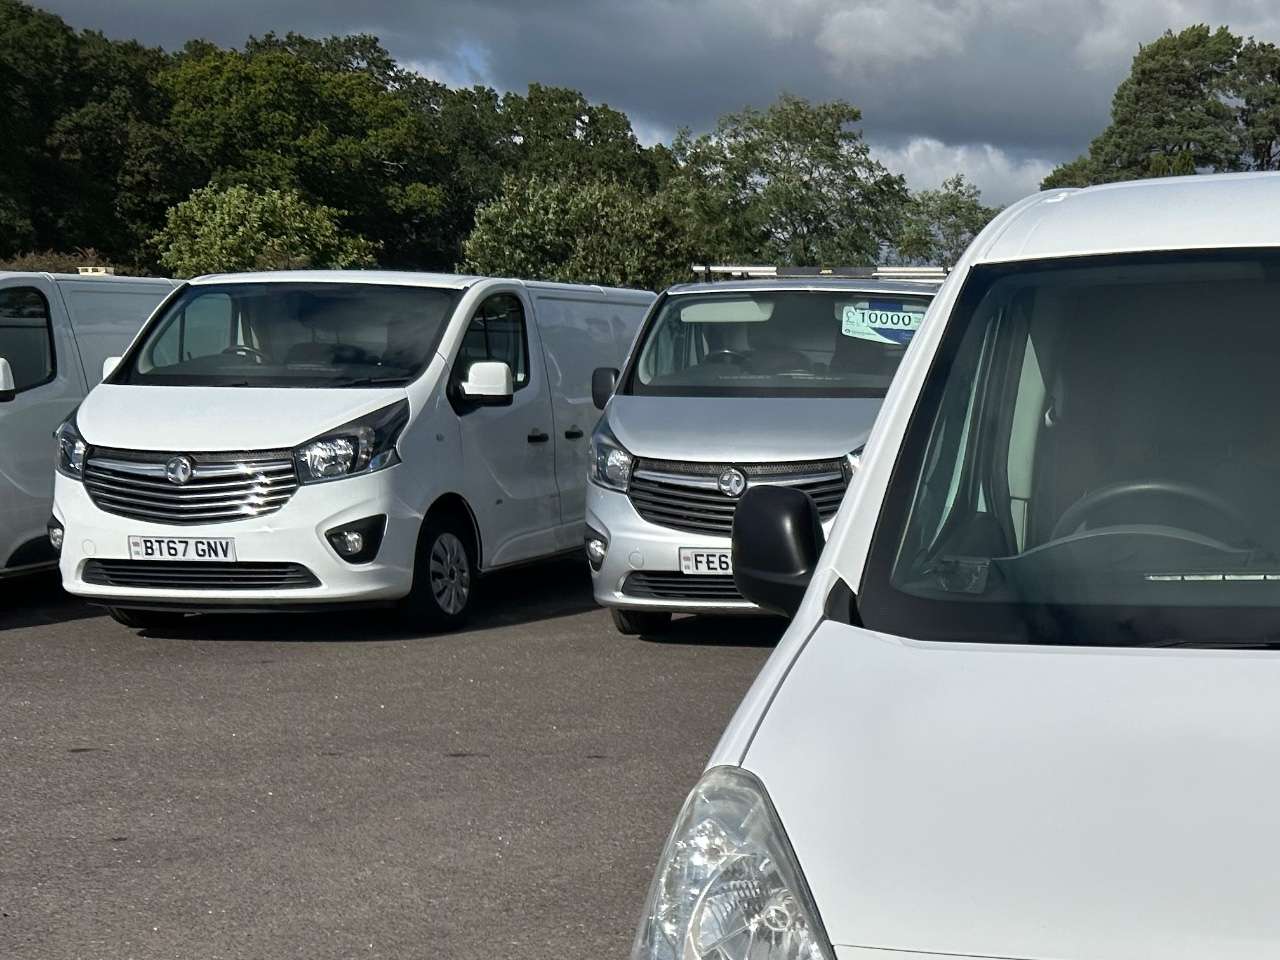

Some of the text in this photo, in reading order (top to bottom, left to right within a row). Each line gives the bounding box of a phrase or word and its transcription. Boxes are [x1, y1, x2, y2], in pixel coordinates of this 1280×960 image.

[143, 540, 230, 558] BT67 GNV
[694, 553, 730, 571] FE6
